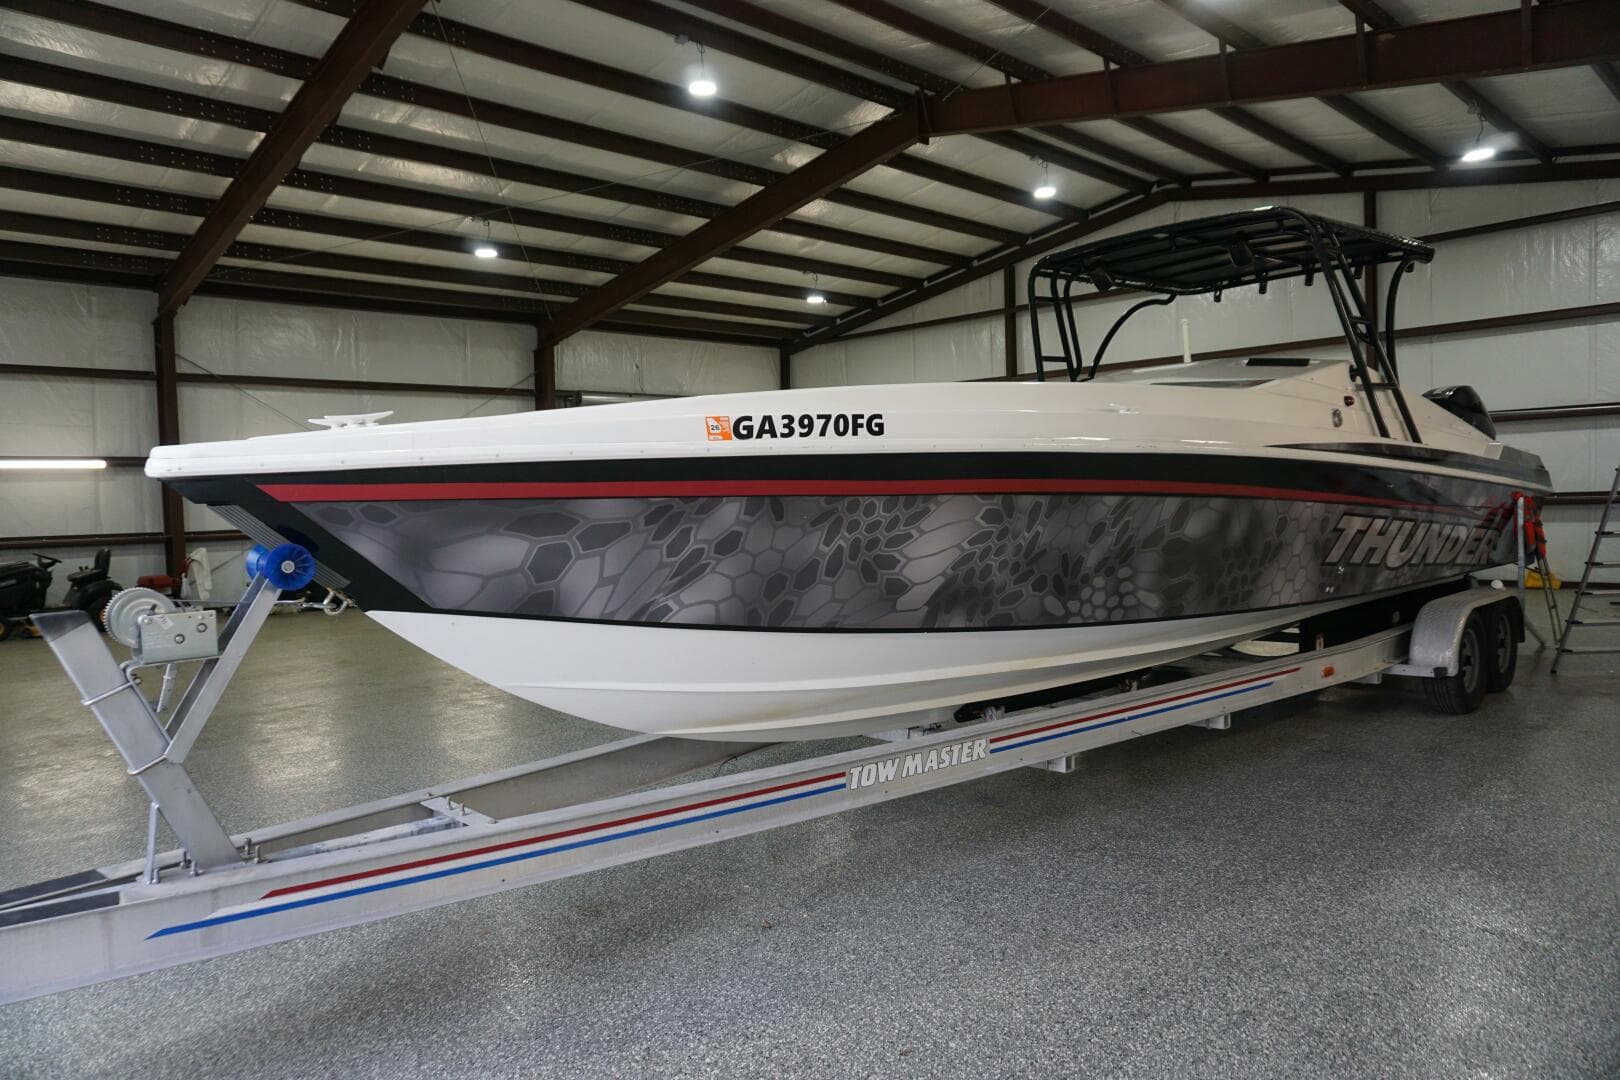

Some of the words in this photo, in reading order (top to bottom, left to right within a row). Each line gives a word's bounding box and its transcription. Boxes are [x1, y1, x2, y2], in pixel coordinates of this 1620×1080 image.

[732, 414, 885, 440] GA3970FG
[1323, 514, 1499, 569] THUNDER
[849, 757, 900, 790] TOW
[901, 738, 988, 778] MASTER
